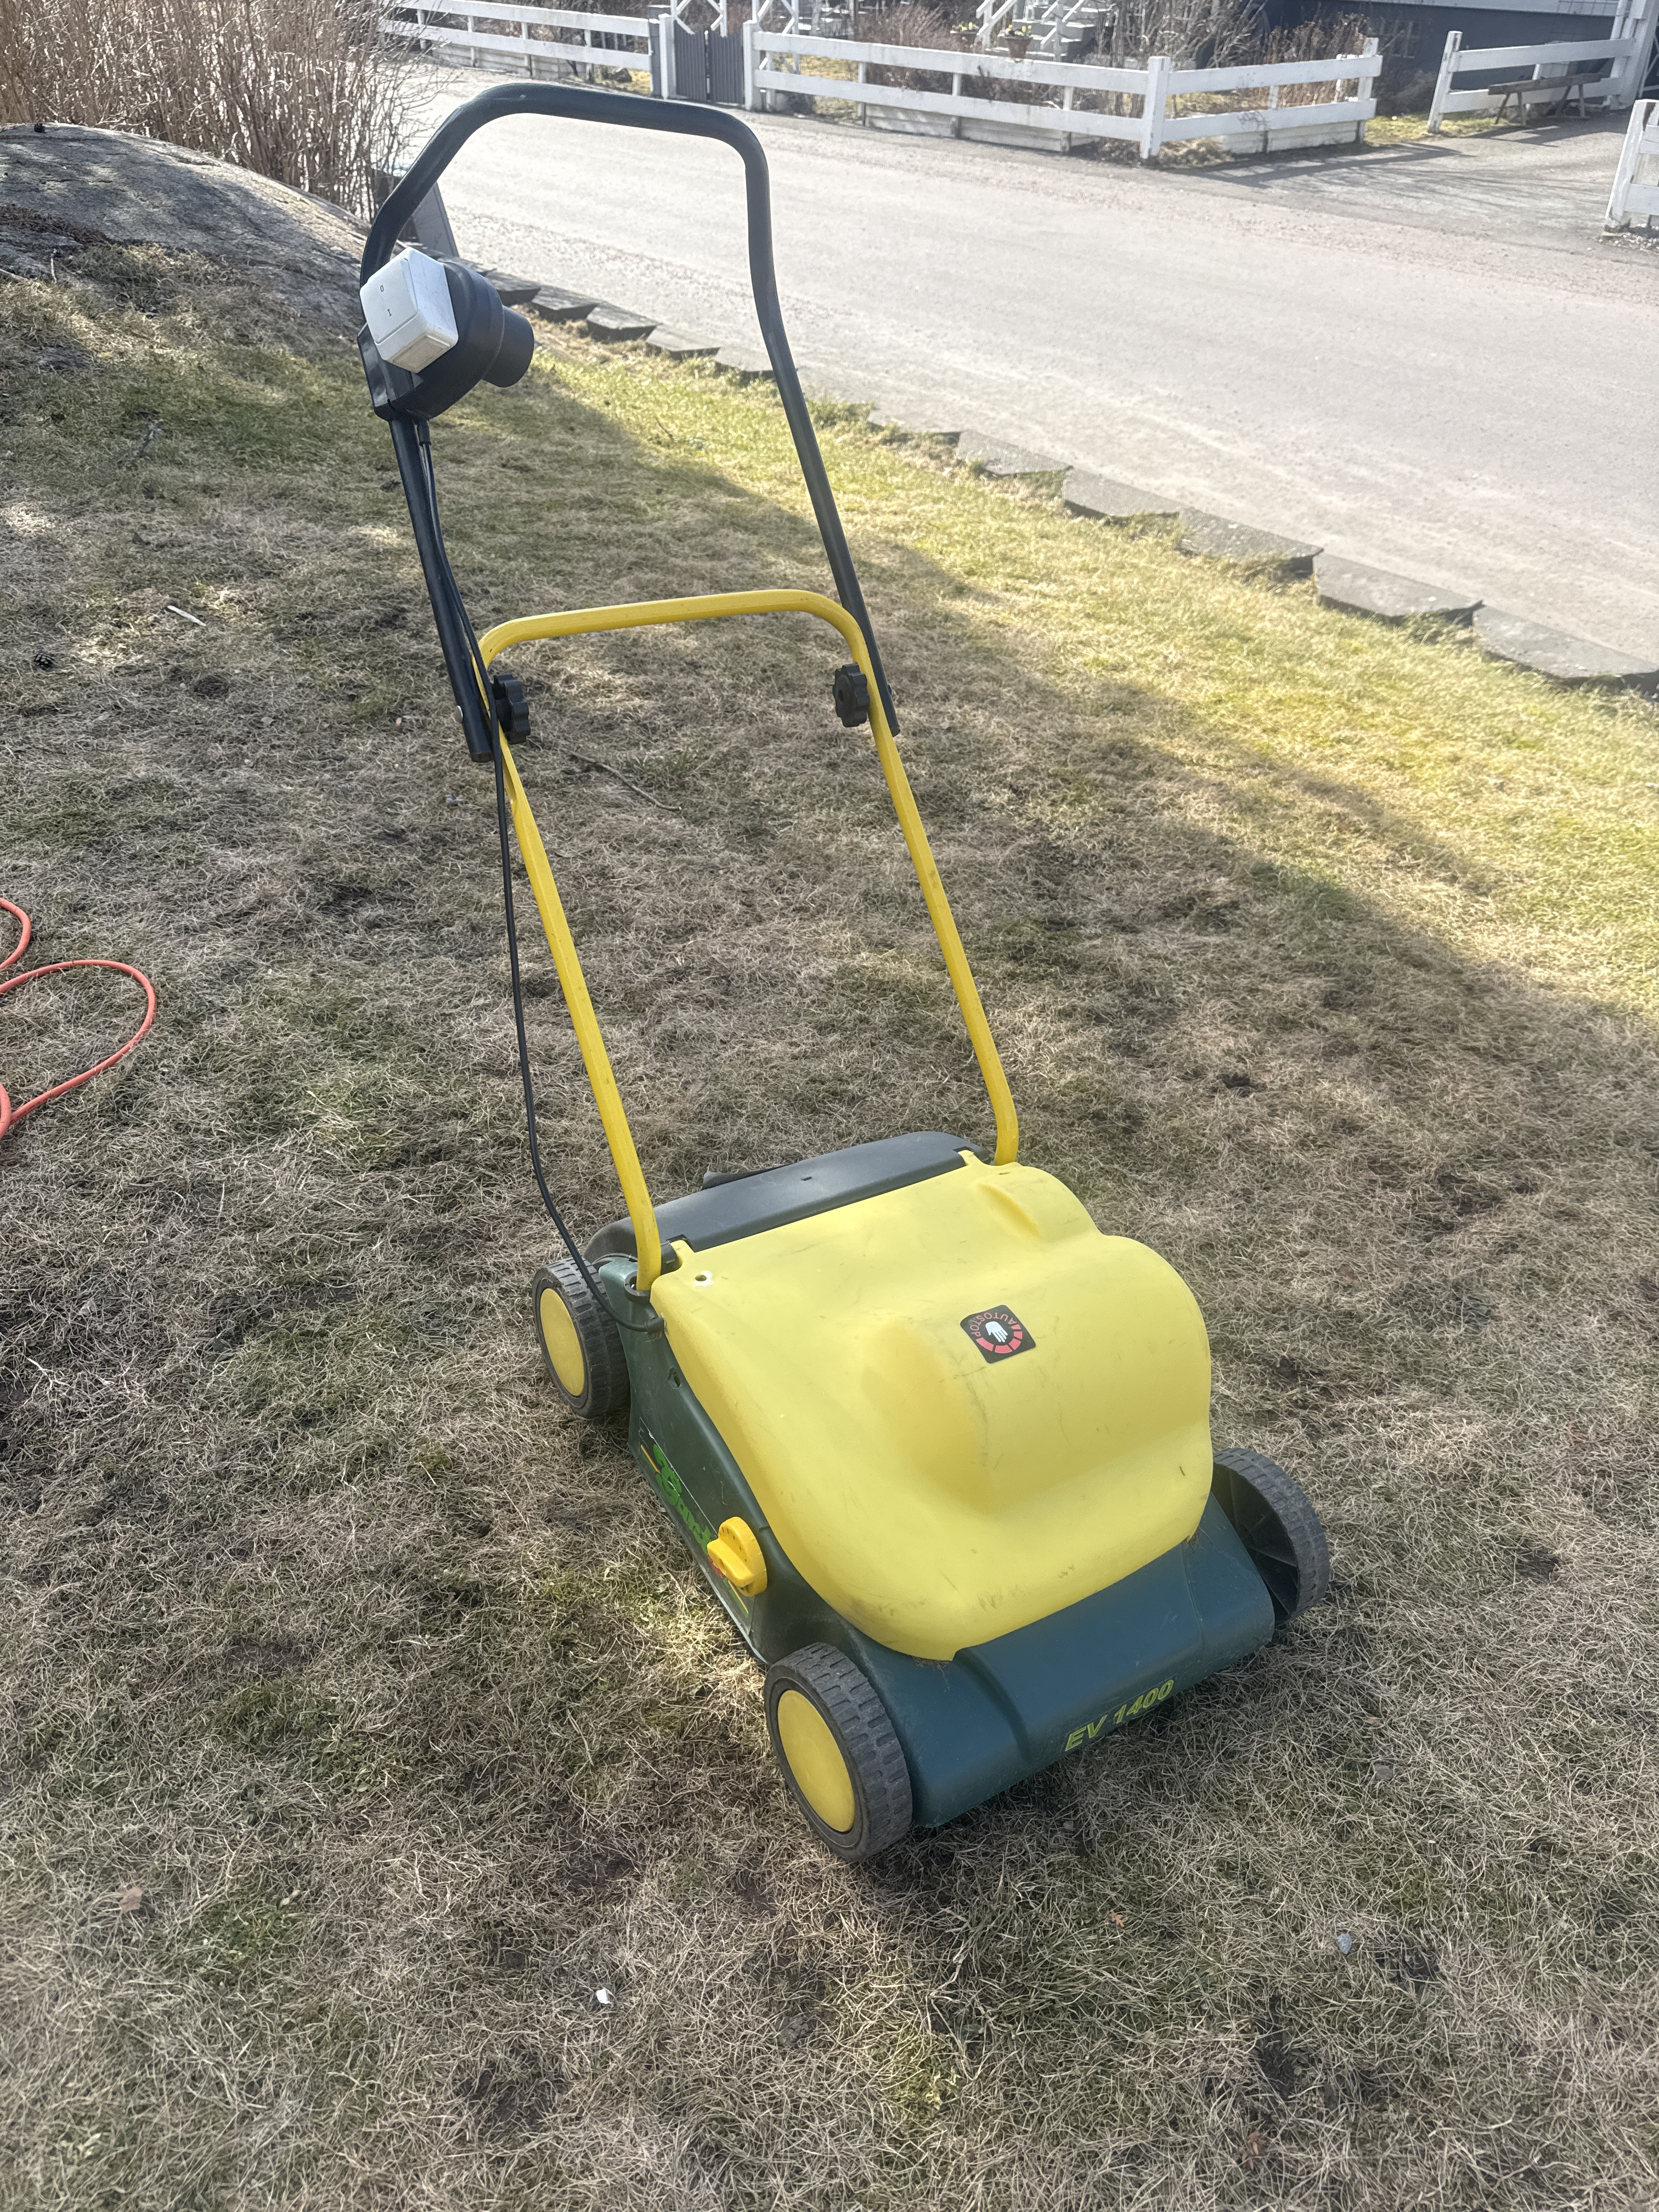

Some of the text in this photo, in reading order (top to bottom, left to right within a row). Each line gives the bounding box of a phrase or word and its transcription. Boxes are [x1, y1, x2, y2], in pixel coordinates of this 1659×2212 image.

[969, 1312, 1018, 1337] AUTOSTOP
[652, 1443, 729, 1585] Gard
[1064, 1679, 1174, 1752] EV 1400
